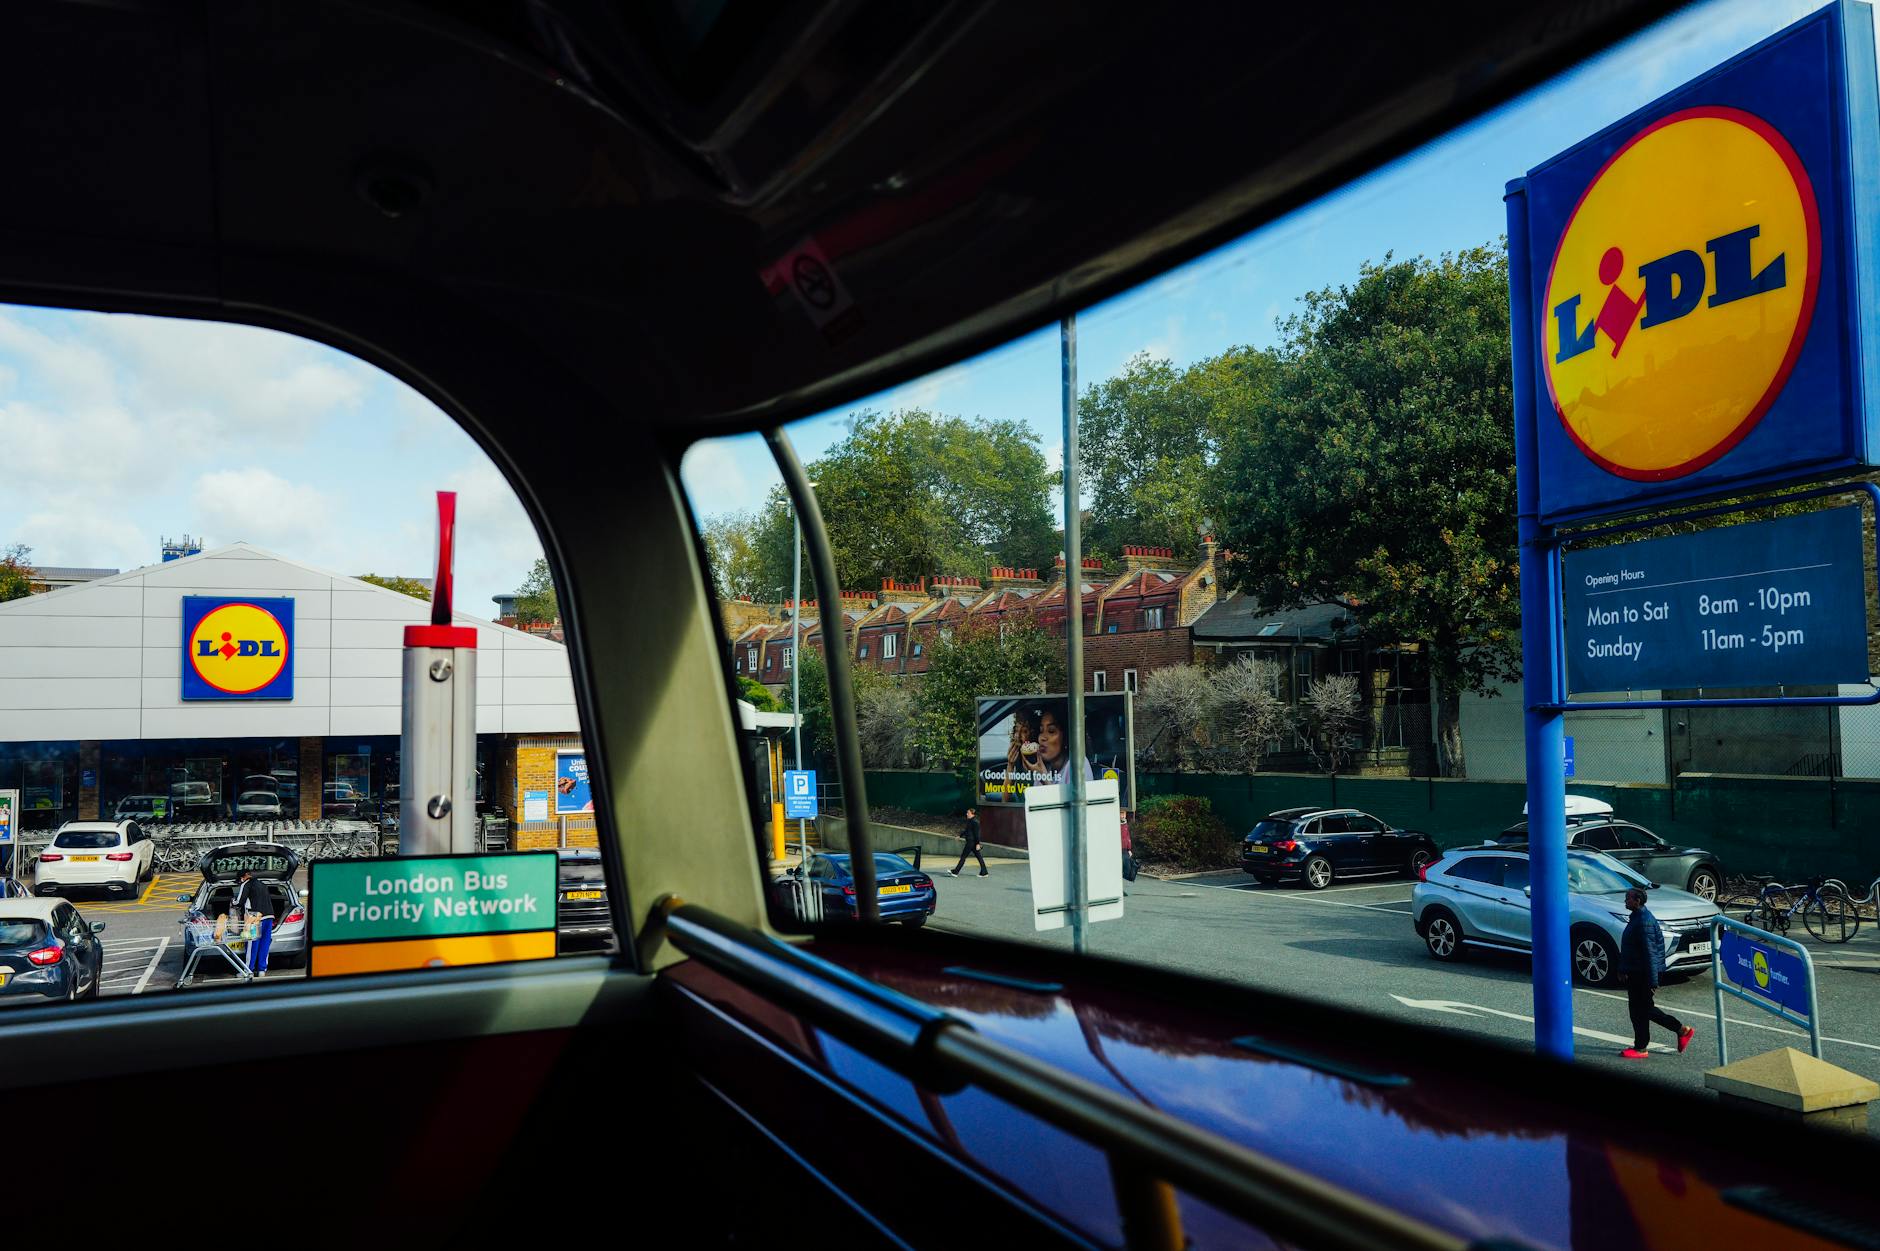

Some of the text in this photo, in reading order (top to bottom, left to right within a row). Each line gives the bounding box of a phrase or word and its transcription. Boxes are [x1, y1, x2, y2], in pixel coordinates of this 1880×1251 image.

[1585, 569, 1645, 588] Opening Hours
[1587, 601, 1670, 627] Mon to Sat
[1699, 595, 1739, 616] 8am
[1587, 635, 1643, 661] Sunday
[1701, 629, 1744, 651] 11am
[1761, 624, 1804, 652] 5pm
[797, 778, 805, 791] P
[984, 769, 1062, 781] Good mood food is
[985, 782, 1005, 793] More
[1007, 784, 1016, 793] to
[366, 871, 508, 896] London Bus
[332, 894, 537, 923] Priority Network
